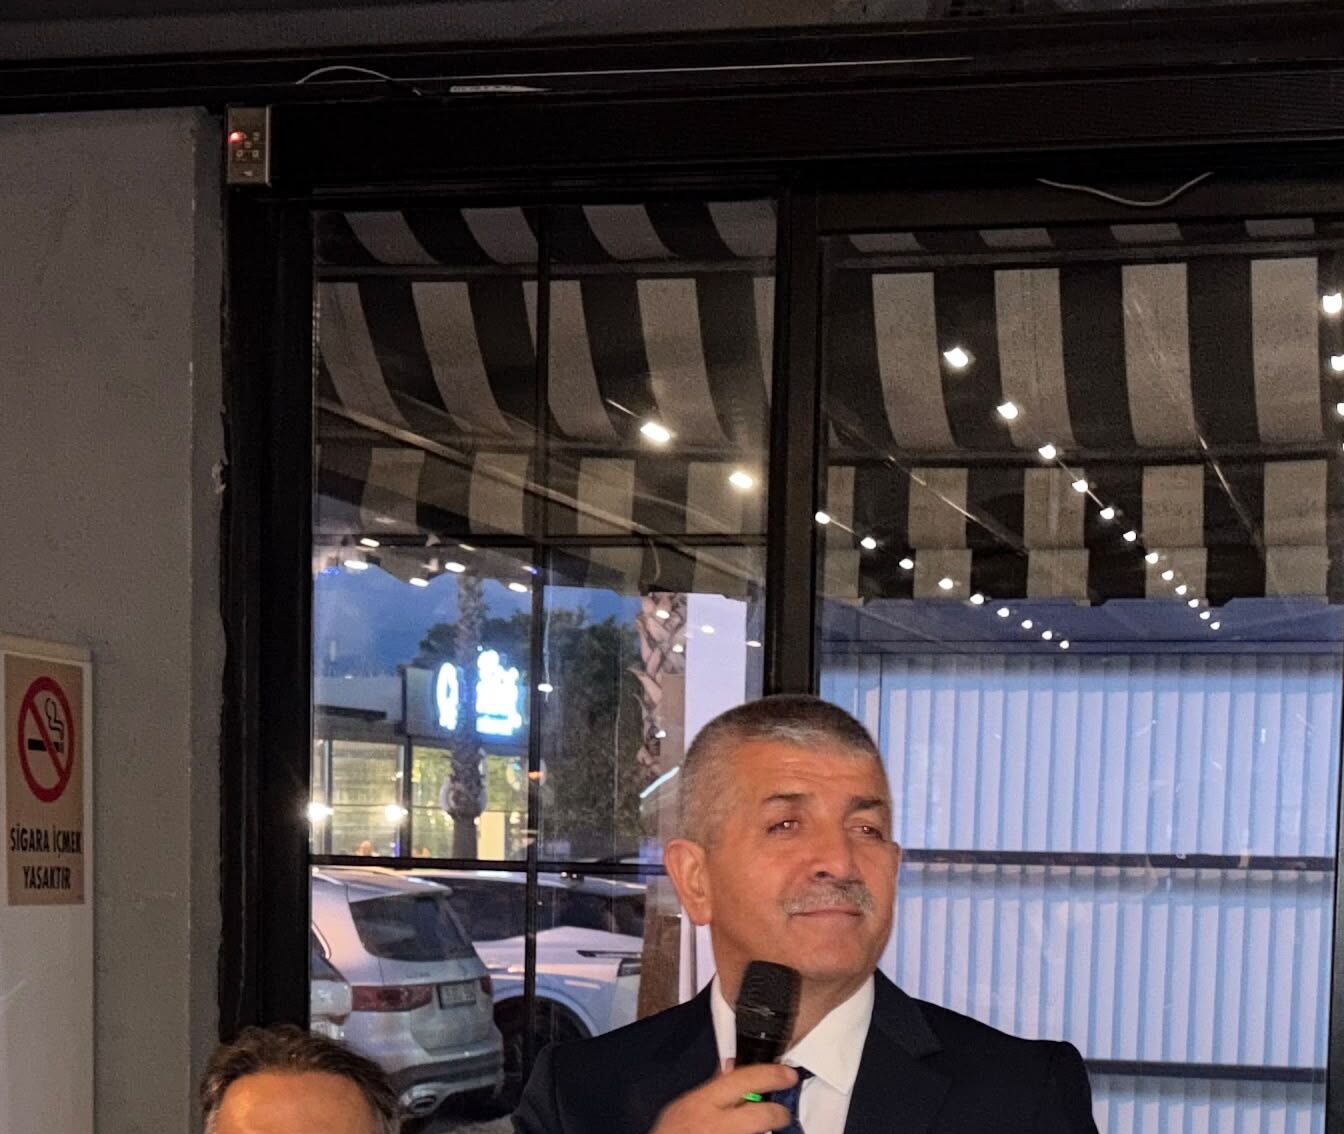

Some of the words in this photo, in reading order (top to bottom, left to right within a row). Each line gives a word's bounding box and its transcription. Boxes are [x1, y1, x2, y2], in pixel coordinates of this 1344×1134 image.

[10, 822, 50, 852] SİGARA
[52, 824, 82, 859] İÇMEK
[23, 866, 71, 890] YASAKTIR
